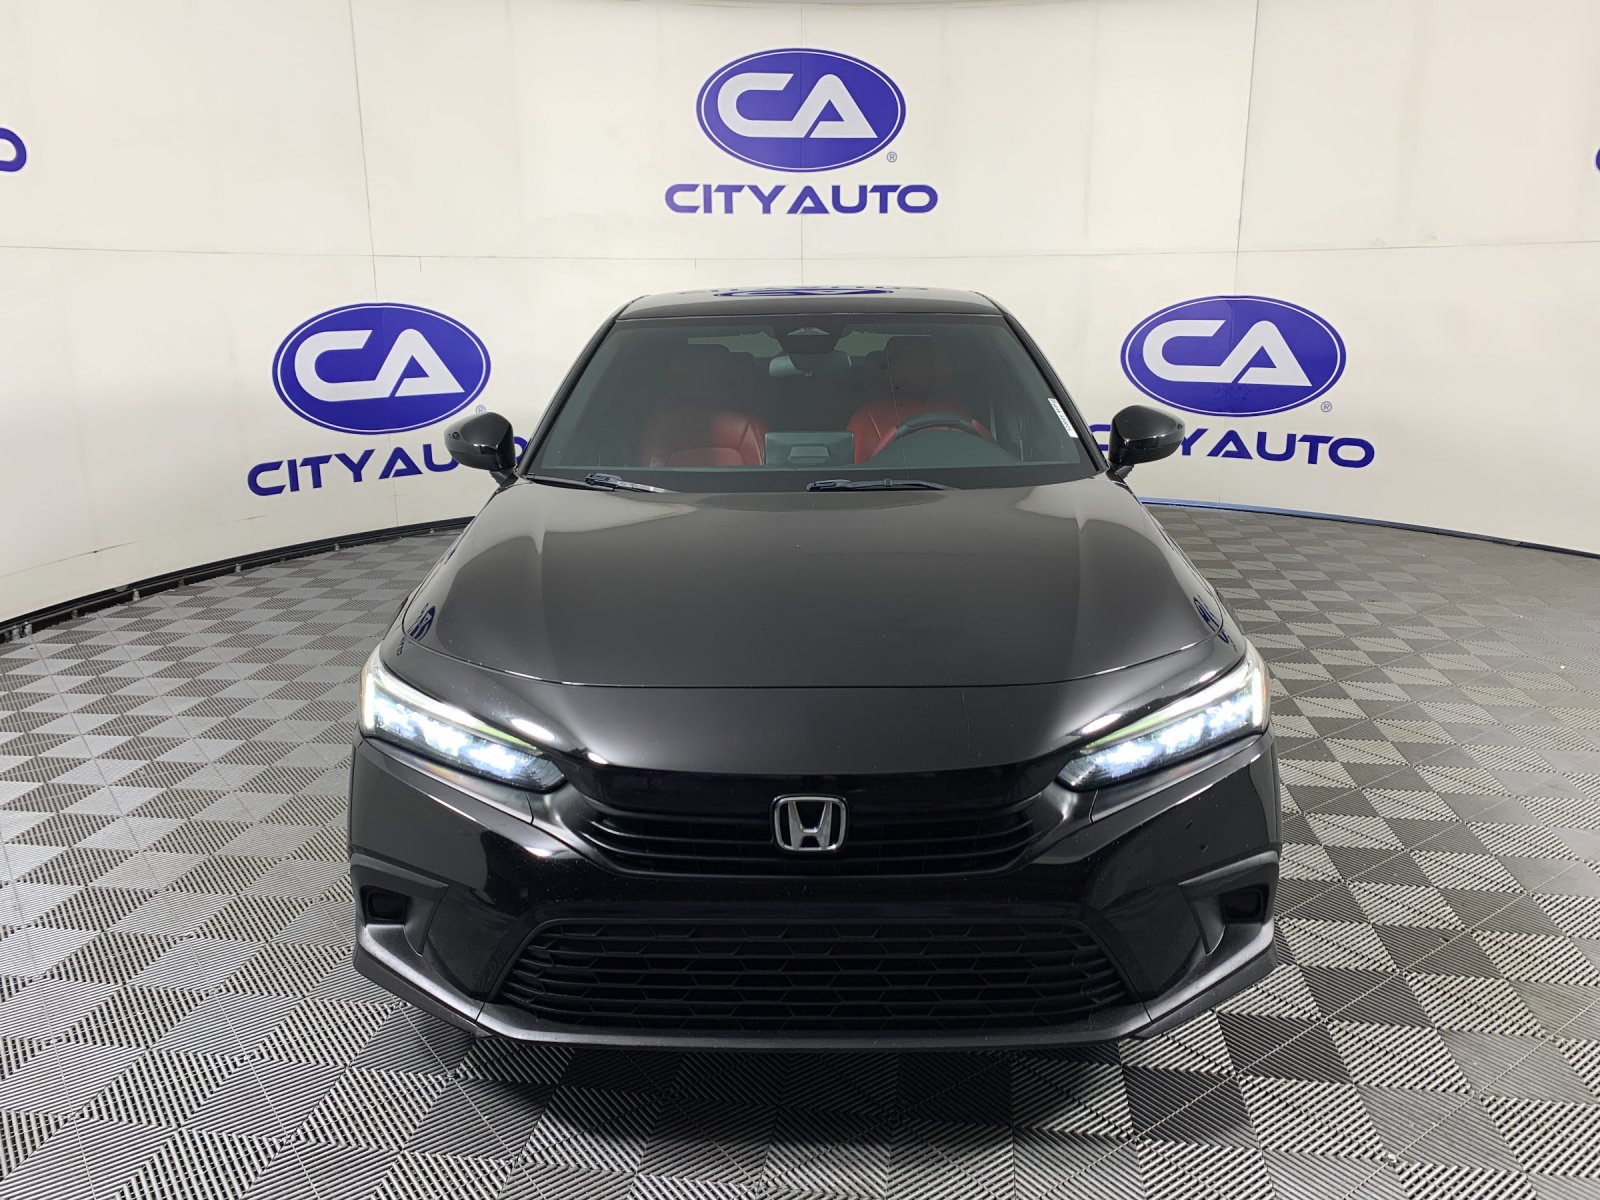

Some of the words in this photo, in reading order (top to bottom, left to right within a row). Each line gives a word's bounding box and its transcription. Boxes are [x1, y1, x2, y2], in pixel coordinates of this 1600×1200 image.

[717, 72, 878, 138] CA
[294, 328, 465, 402] CA
[1142, 319, 1312, 387] CA
